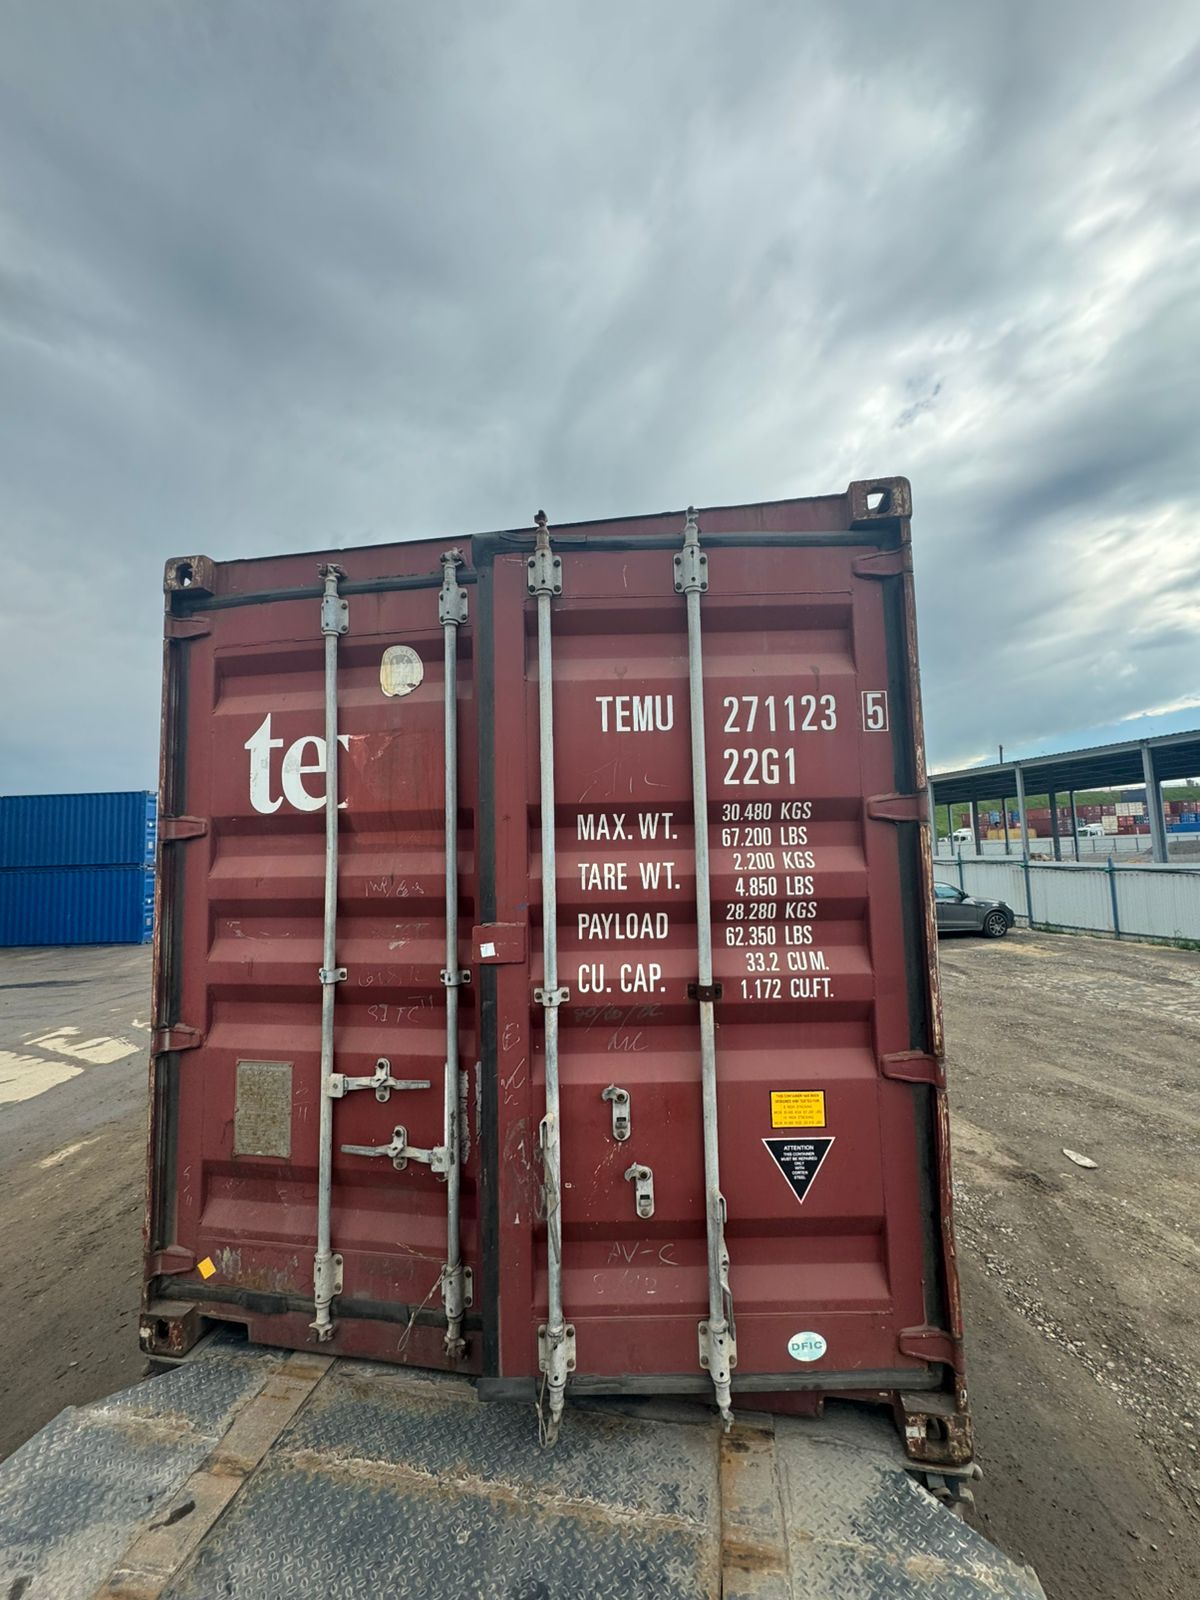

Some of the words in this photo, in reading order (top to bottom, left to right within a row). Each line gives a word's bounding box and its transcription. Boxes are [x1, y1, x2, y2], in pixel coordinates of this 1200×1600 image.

[595, 694, 674, 732] TEMU
[723, 694, 837, 732] 271123
[865, 692, 884, 730] 5
[723, 747, 796, 785] 22G1
[722, 802, 772, 821] 30.480
[780, 801, 812, 820] KGS
[722, 827, 772, 847] 67.200
[780, 826, 808, 846] LBS
[733, 852, 775, 871] 2.200
[782, 851, 816, 869] KGS
[577, 862, 628, 890] TARE
[638, 862, 680, 890] WT.
[786, 875, 814, 896] LBS
[725, 902, 777, 920] 28.280
[785, 901, 818, 919] KGS
[578, 912, 669, 940] PAYLOAD
[725, 925, 776, 946] 62.350
[785, 924, 813, 945] LBS
[745, 952, 780, 972] 33.2
[783, 1144, 815, 1152] ATTENTION
[791, 1340, 823, 1351] DFIC
